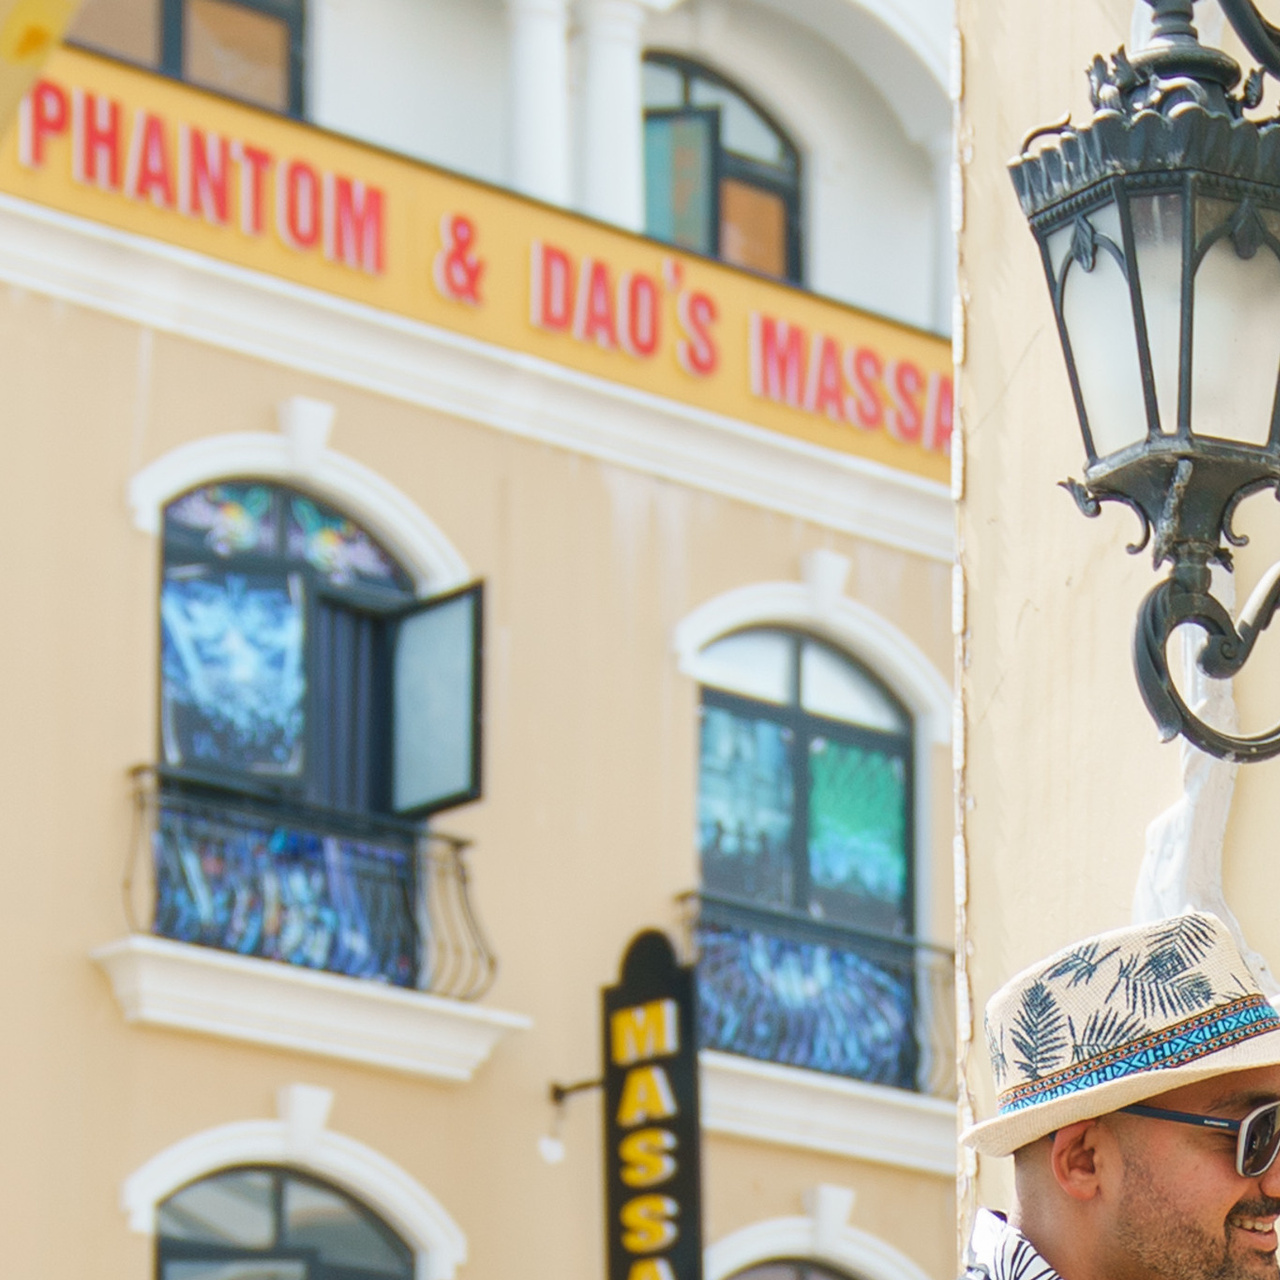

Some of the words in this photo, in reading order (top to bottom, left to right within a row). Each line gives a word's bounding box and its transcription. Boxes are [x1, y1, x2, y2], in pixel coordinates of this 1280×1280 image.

[19, 78, 387, 277] PHANTOM
[433, 212, 485, 306] &
[530, 240, 718, 377] DAO'S
